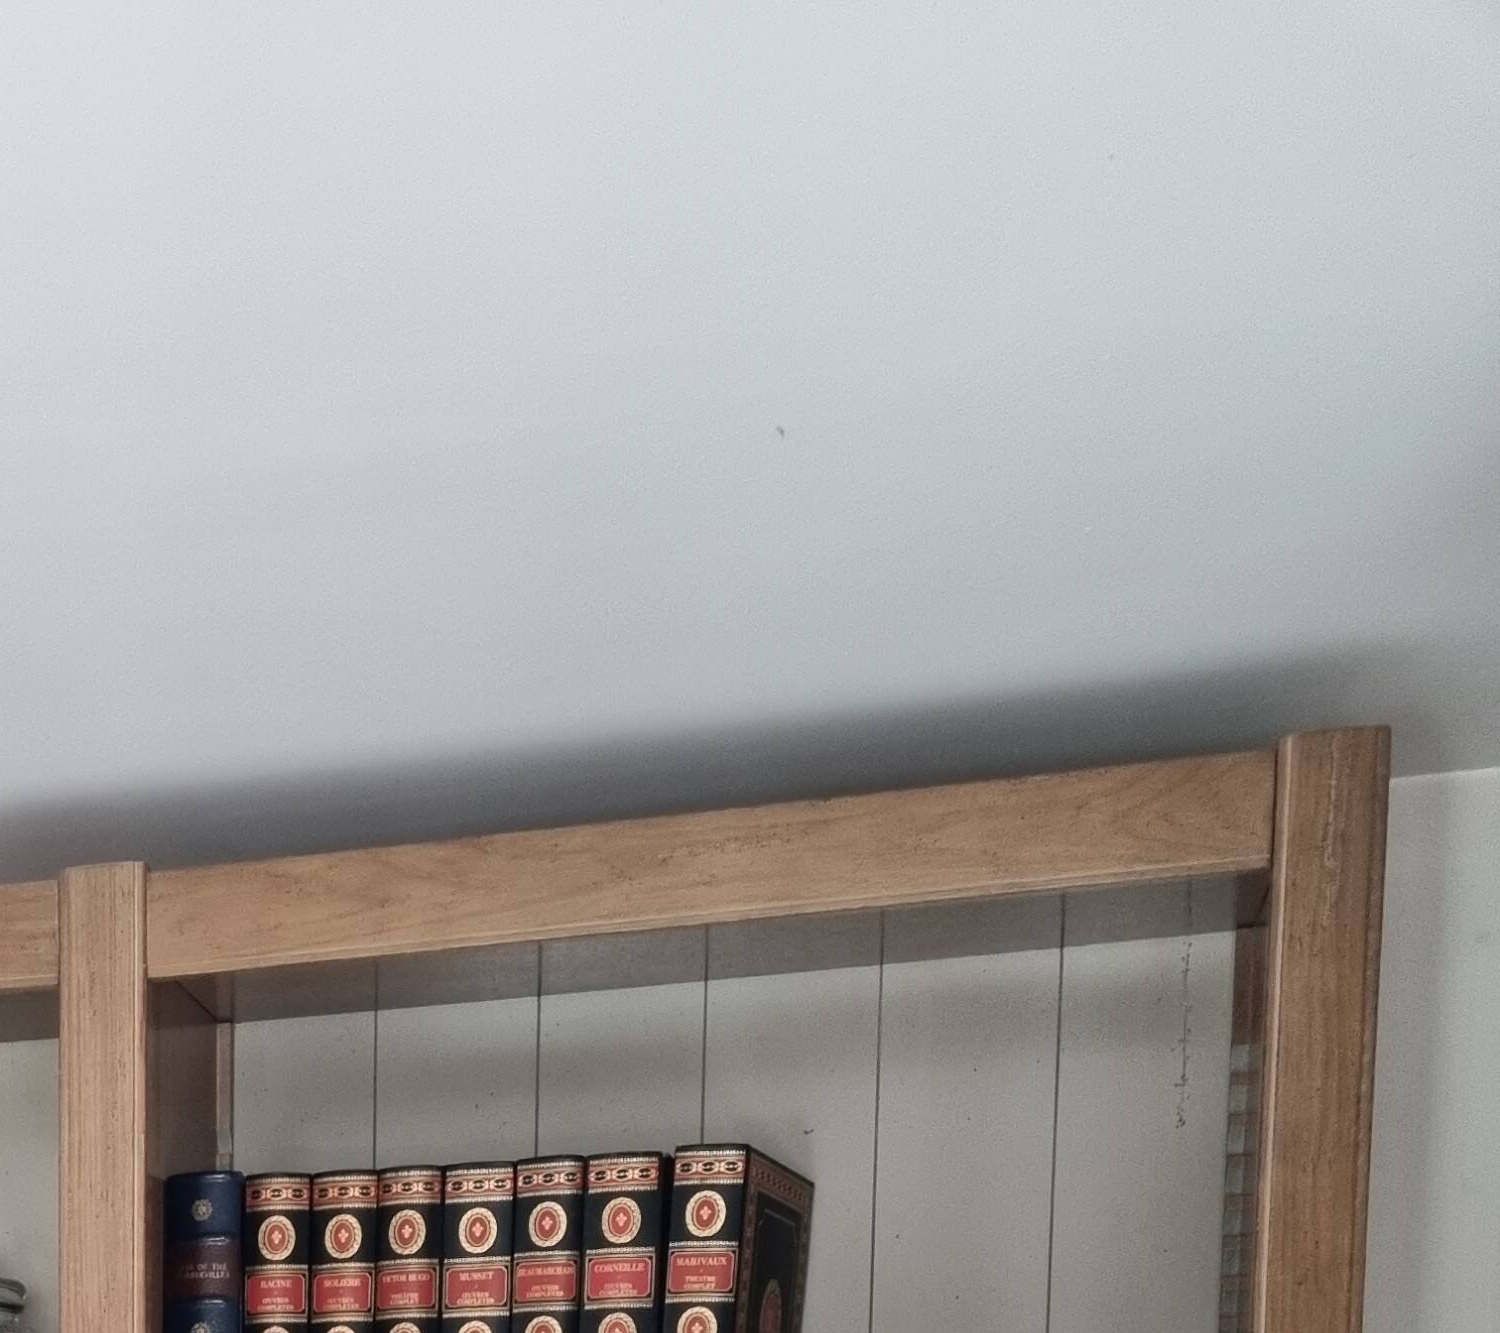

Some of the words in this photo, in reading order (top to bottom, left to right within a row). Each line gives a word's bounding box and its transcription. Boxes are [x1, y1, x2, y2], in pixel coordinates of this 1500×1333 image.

[676, 1256, 728, 1266] MARIVAUX
[594, 1263, 645, 1273] CORNEILLE
[459, 1271, 494, 1281] MUSSET
[260, 1279, 292, 1289] RACINE
